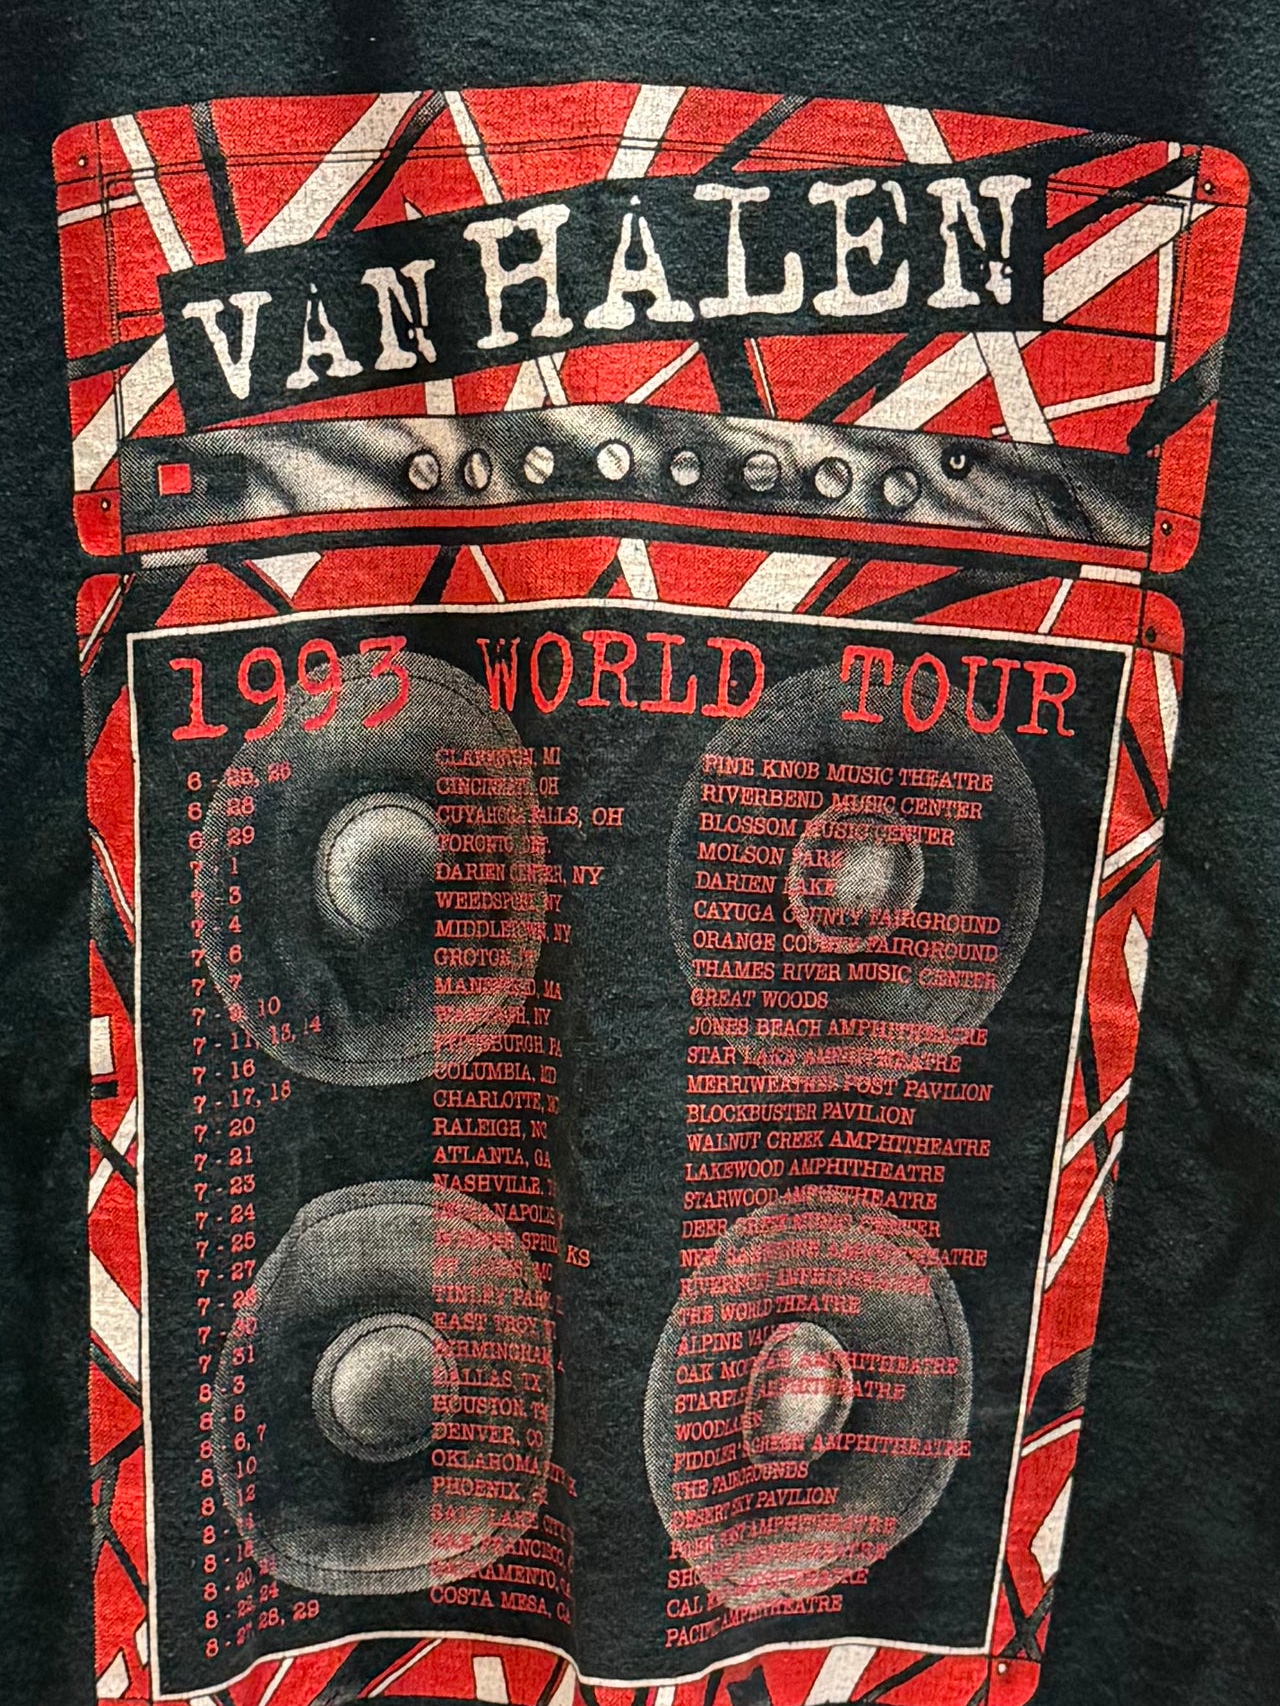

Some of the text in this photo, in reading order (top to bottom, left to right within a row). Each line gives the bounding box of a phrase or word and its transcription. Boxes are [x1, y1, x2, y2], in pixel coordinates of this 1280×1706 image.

[182, 176, 1031, 400] VAN HALEN
[169, 629, 1077, 741] 1993 WORLD TOUR
[703, 755, 992, 792] PINE KNOB MUSIC THEATRE
[539, 778, 559, 796] OH
[187, 803, 202, 821] 6
[702, 785, 981, 821] RIVERBEND MUSIC CENTER
[592, 806, 624, 828] OH
[700, 813, 953, 846] BLOSSOM MUSIC CENTER
[188, 826, 254, 851] 6 29
[698, 843, 845, 870] MOLSON PARK
[435, 863, 504, 881] DARIEN
[572, 867, 604, 886] NY
[696, 872, 837, 897] DARIEN LAKE
[693, 901, 999, 935] CAYUGA COUNTY FAIRGROUND
[228, 945, 241, 964] 6
[692, 931, 997, 963] ORANGE COUNTY FAIRGROUND
[692, 960, 996, 990] THAMES RIVER MUSIC CENTER
[690, 987, 827, 1010] GREAT WOODS
[688, 1017, 987, 1047] JONES BEACH AMPHITHEATRE
[687, 1046, 736, 1066] STAR
[192, 1060, 254, 1085] 7 16
[194, 1097, 206, 1113] 7
[271, 1081, 290, 1102] 18
[842, 1074, 897, 1097] POST
[903, 1080, 991, 1102] PAVILION
[686, 1103, 914, 1126] BLOCKBUSTER PAVILION
[193, 1117, 254, 1142] 7 20
[433, 1118, 526, 1139] RALEIGH,
[434, 1146, 528, 1167] ATLANTA,
[687, 1131, 990, 1157] WALNUT CREEK AMPHITHEATRE
[194, 1147, 251, 1171] 7 21
[685, 1159, 944, 1184] LAKEWOOD AMPHITHEATRE
[194, 1175, 255, 1201] 7 23
[684, 1185, 936, 1211] STARWOOD AMPHITHEATRE
[195, 1204, 254, 1229] 7 24
[682, 1219, 726, 1239] DEER
[195, 1232, 254, 1258] 7 25
[566, 1246, 589, 1268] KS
[680, 1247, 721, 1269] NEW
[196, 1260, 255, 1287] 7 27
[433, 1311, 487, 1332] EAST
[677, 1295, 860, 1327] THE WORLD THEATRE
[677, 1332, 743, 1357] ALPINE
[675, 1363, 713, 1385] OAK
[198, 1376, 244, 1403] 8 3
[199, 1405, 245, 1432] 8 5
[432, 1423, 520, 1446] DENVER,
[811, 1433, 970, 1458] AMPHITHEATRE
[672, 1479, 708, 1501] THE
[755, 1488, 838, 1509] PAVILION
[292, 1600, 319, 1621] 29
[429, 1585, 493, 1608] COSTA
[500, 1593, 551, 1617] MESA,
[666, 1597, 702, 1619] CAL
